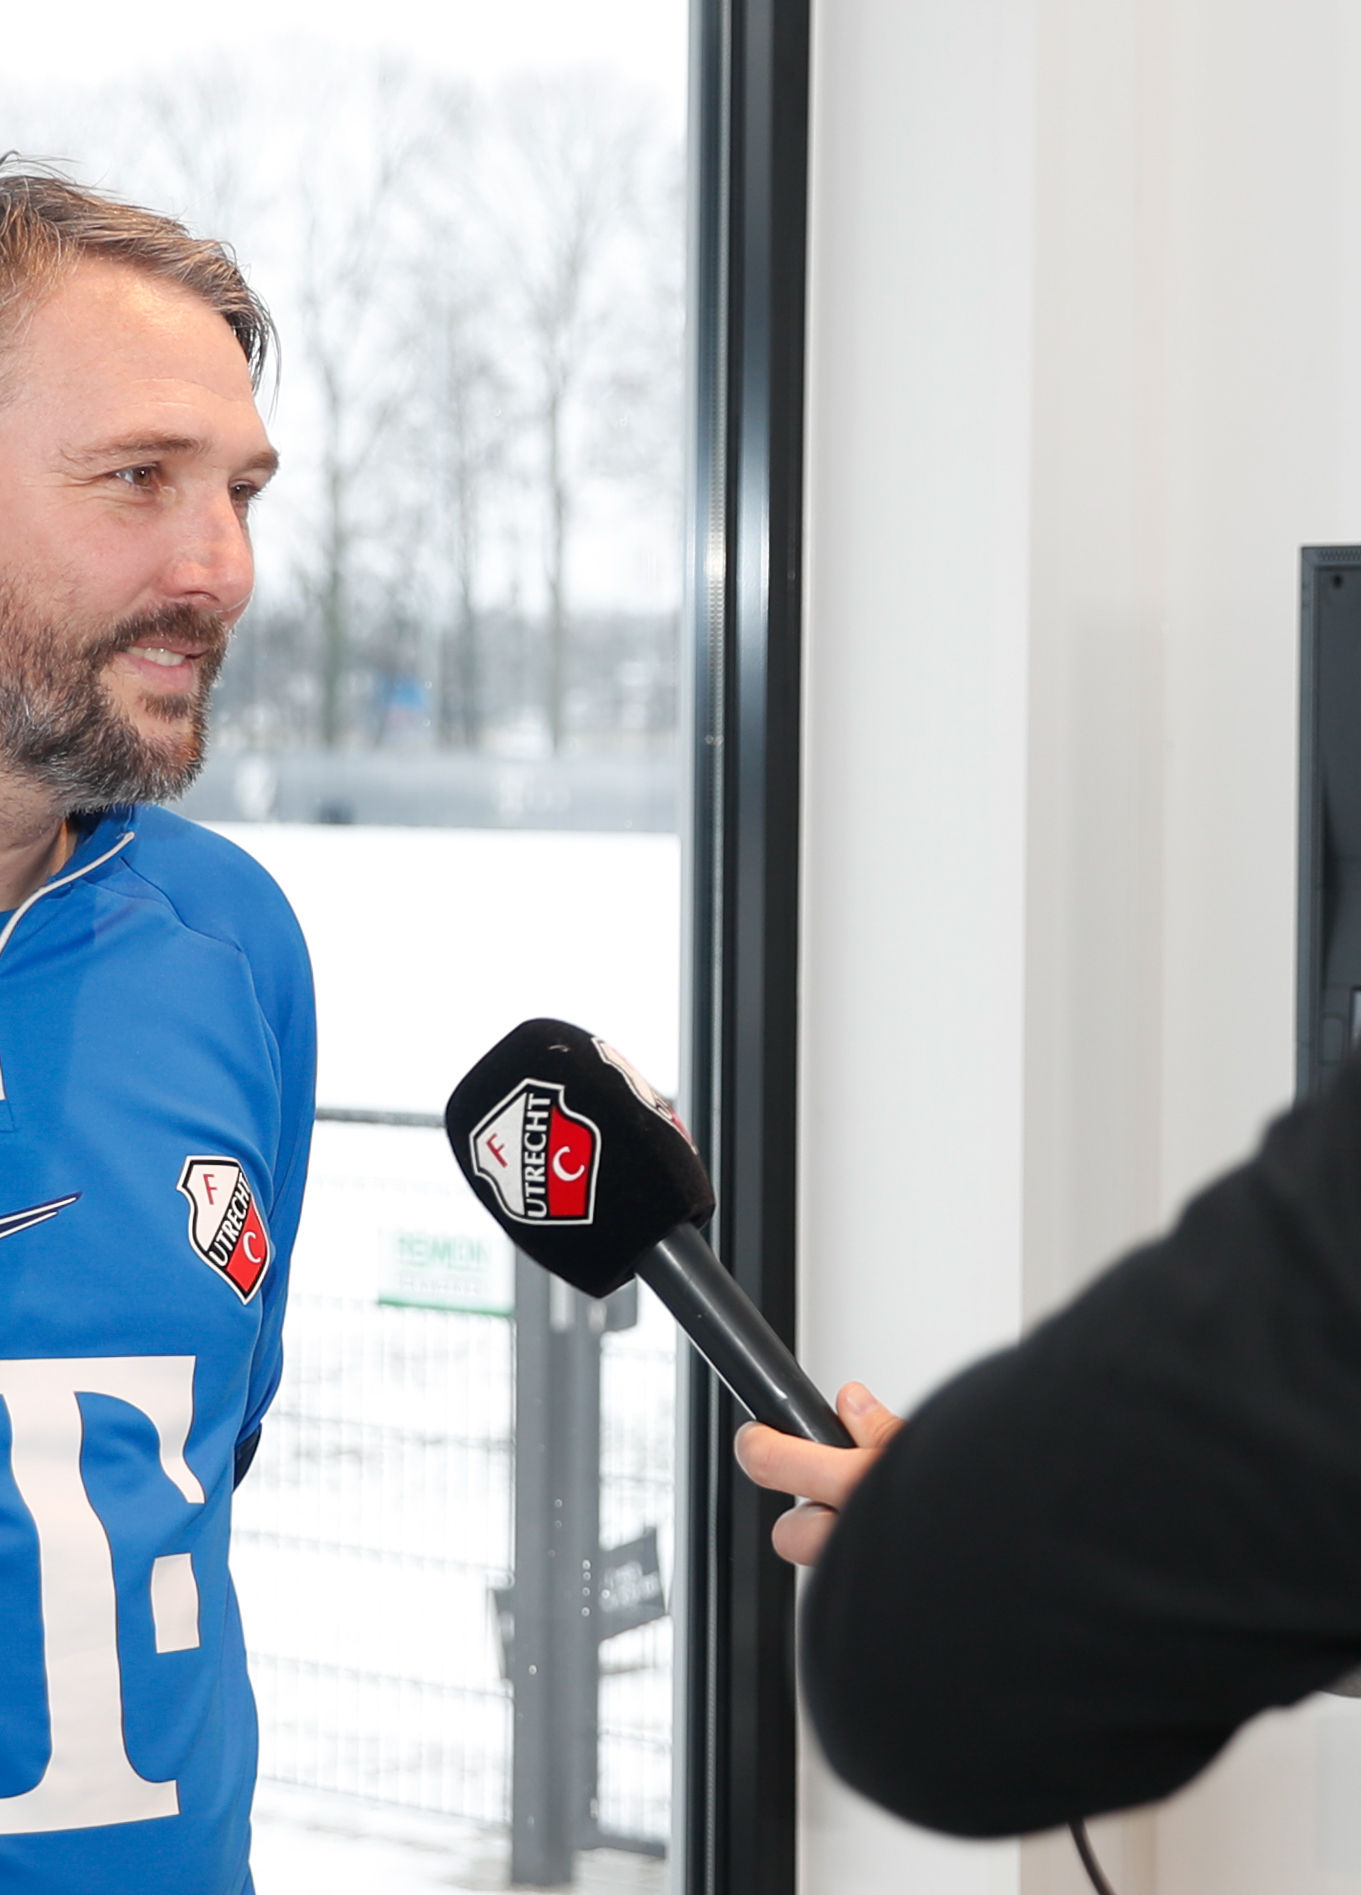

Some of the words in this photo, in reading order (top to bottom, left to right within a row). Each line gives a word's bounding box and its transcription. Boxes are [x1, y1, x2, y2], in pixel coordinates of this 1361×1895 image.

[485, 1133, 509, 1168] F
[524, 1092, 551, 1218] UTRECHT
[552, 1146, 585, 1181] C
[202, 1173, 219, 1205] F
[208, 1172, 251, 1267] UTRECHT
[242, 1231, 262, 1263] C
